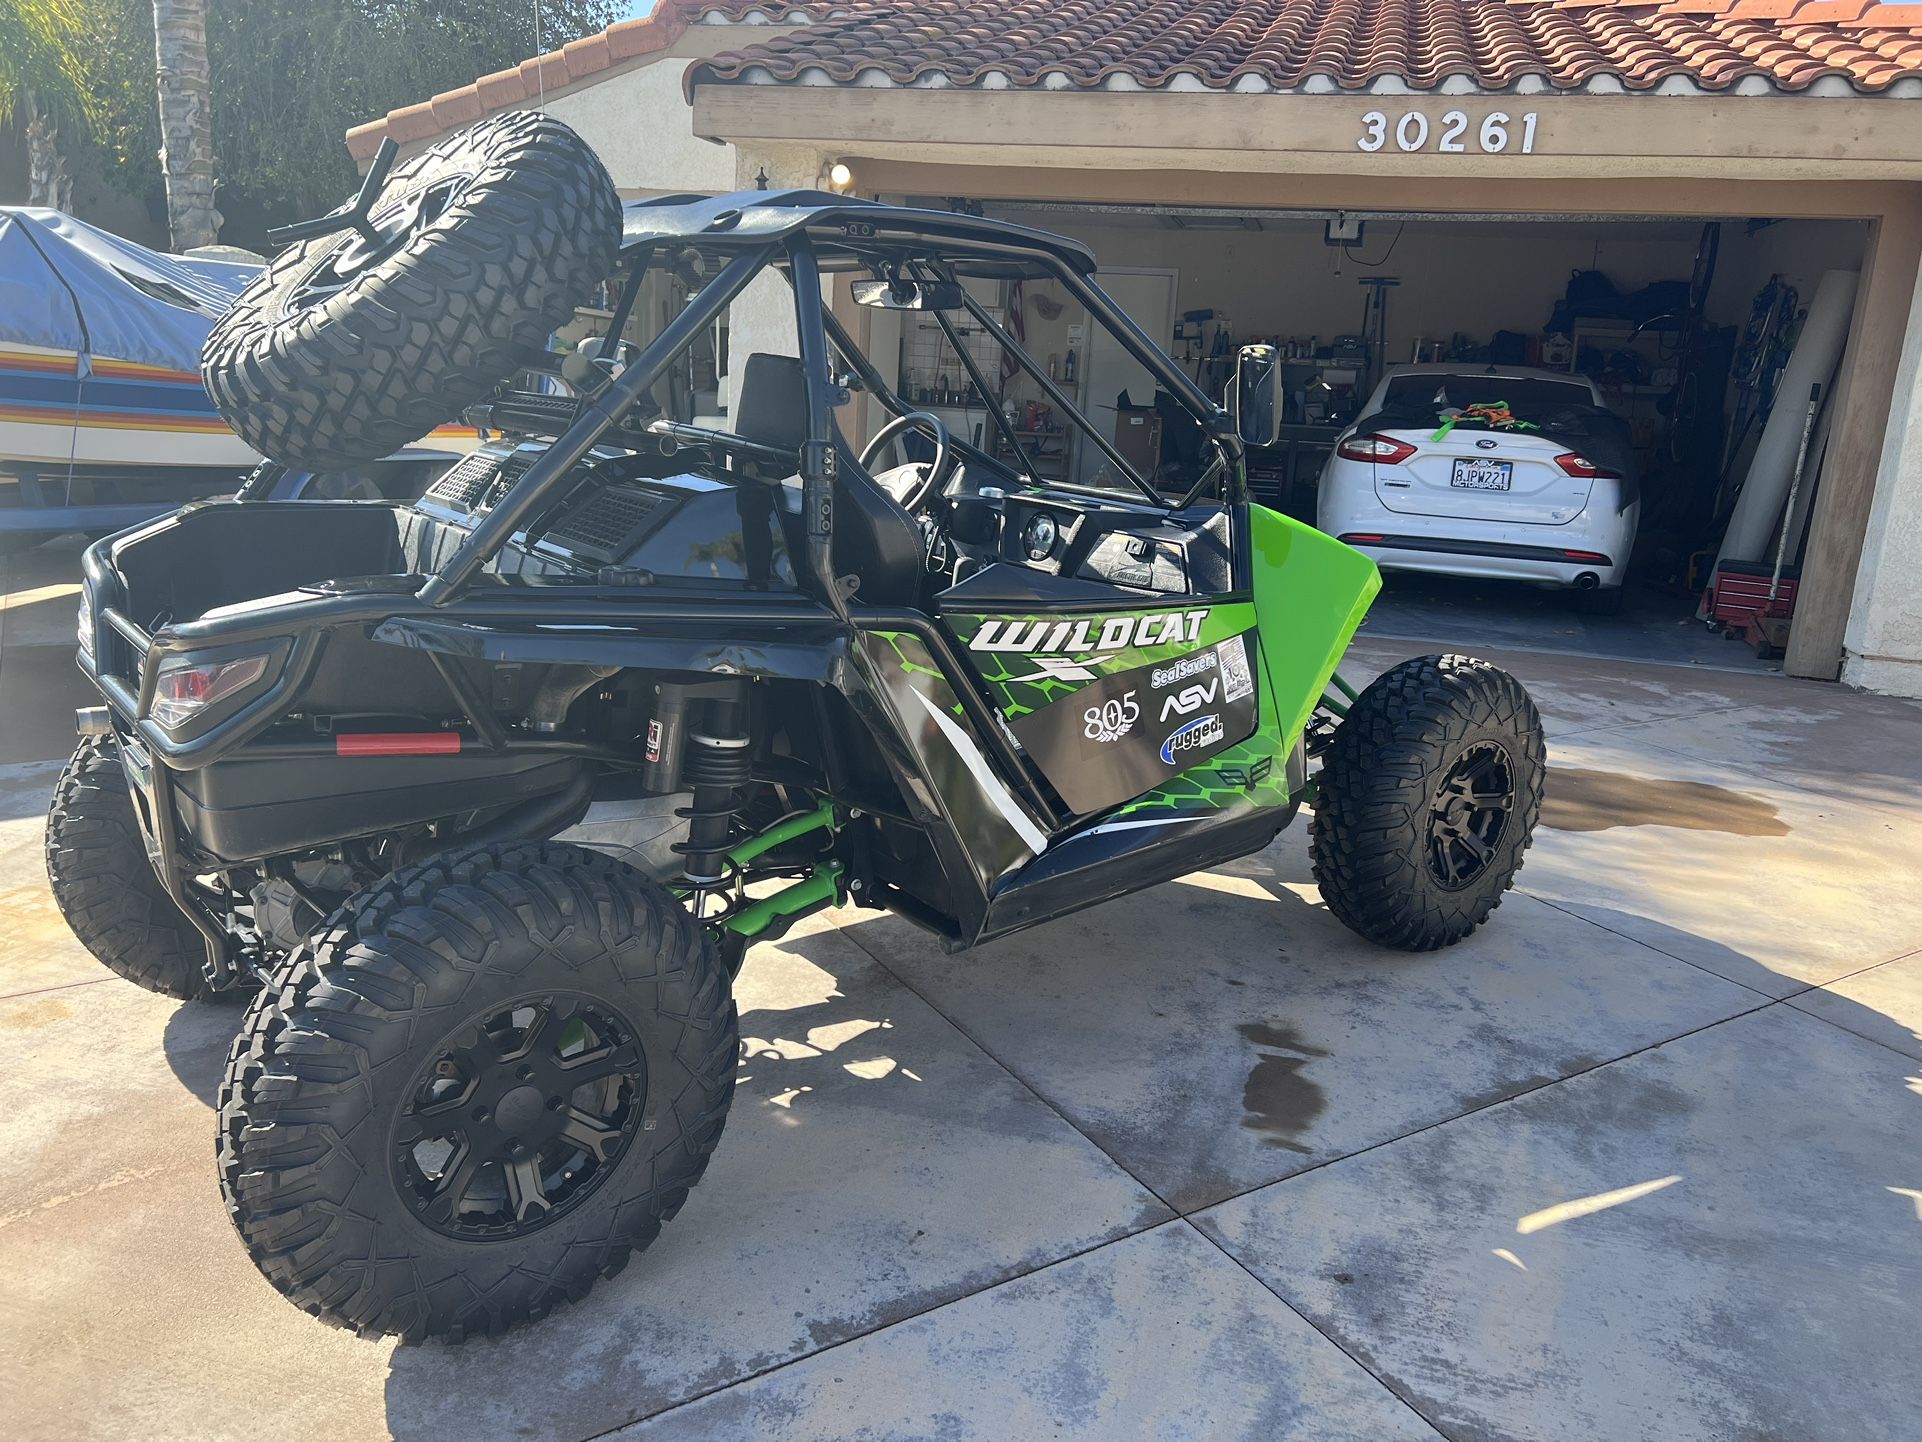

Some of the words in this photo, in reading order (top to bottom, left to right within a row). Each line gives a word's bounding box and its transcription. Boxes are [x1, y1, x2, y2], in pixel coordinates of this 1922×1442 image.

[1357, 110, 1537, 154] 30261
[1452, 480, 1509, 490] MOTORSPORTS
[1455, 469, 1506, 484] 8JPW221
[969, 610, 1209, 652] WILDCAT
[1151, 652, 1217, 688] SealSavers
[1084, 690, 1140, 739] 805
[1160, 677, 1218, 722] ASV
